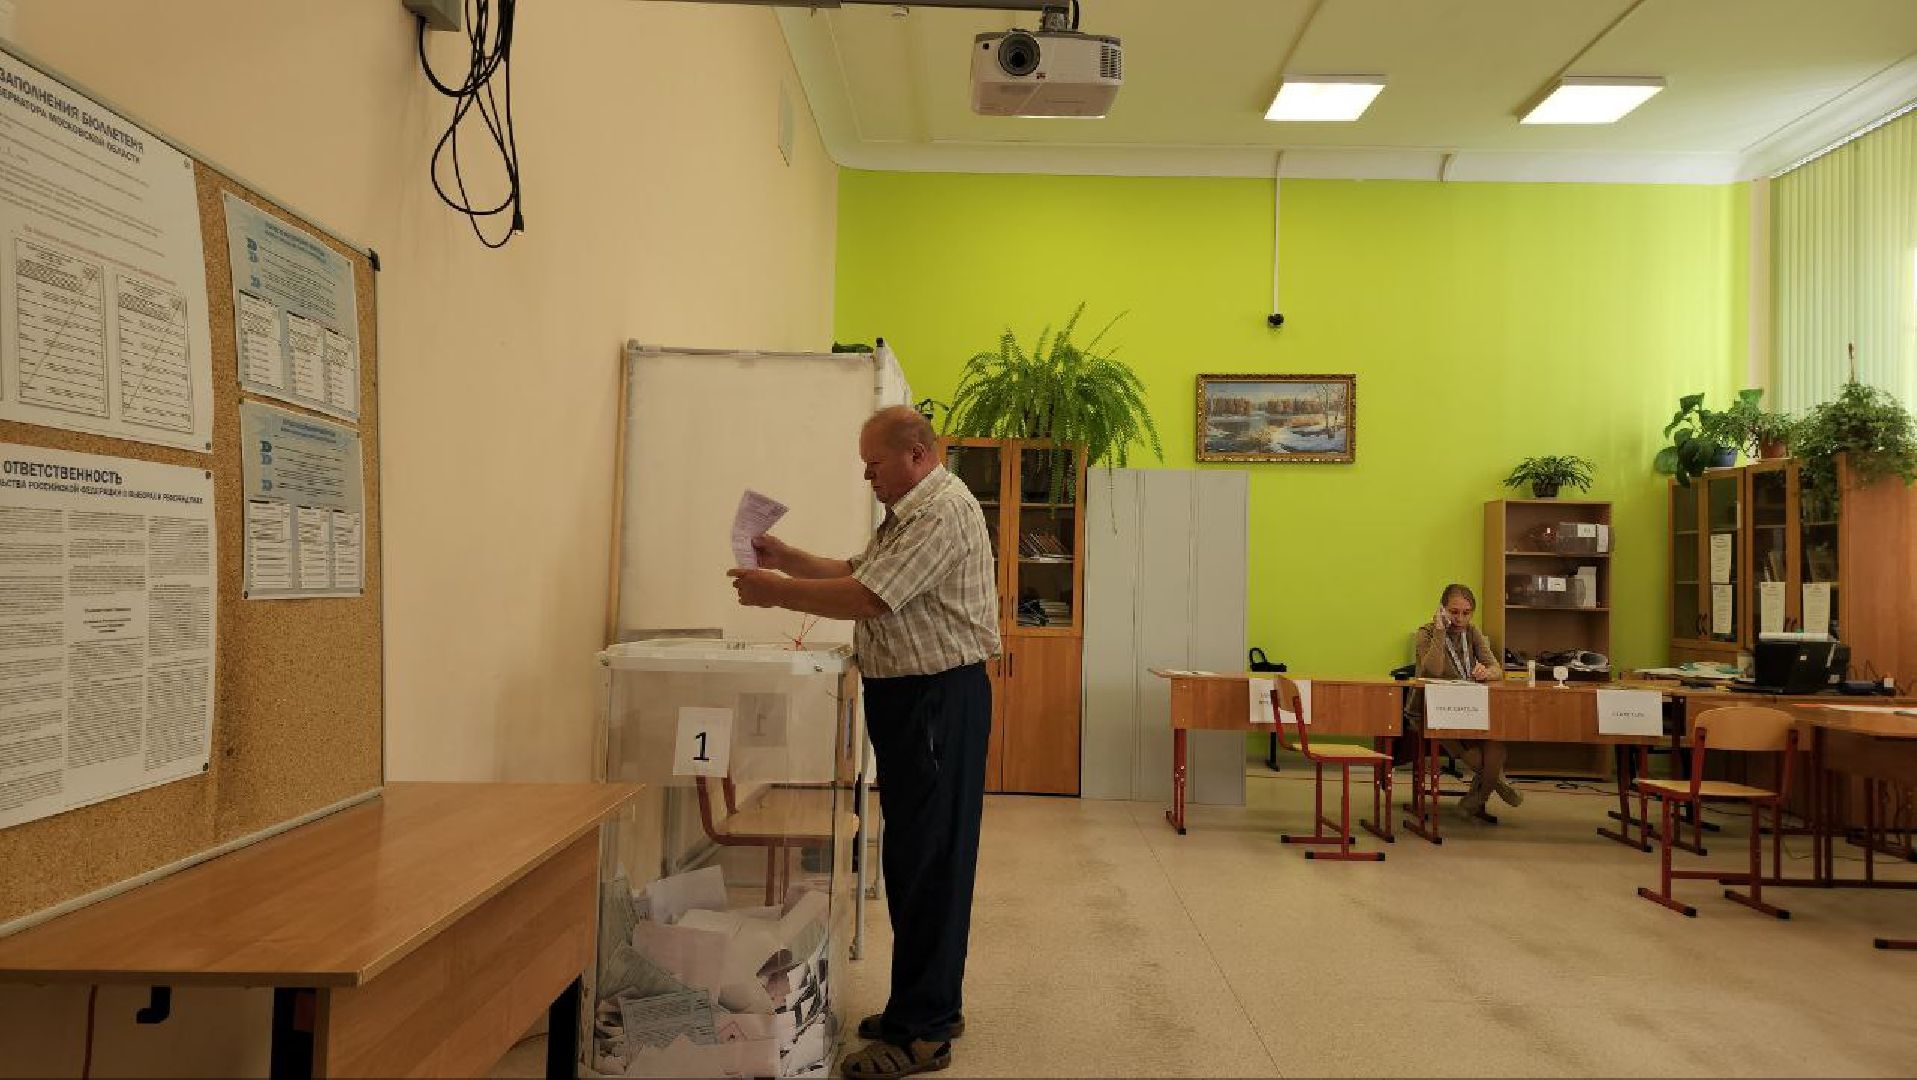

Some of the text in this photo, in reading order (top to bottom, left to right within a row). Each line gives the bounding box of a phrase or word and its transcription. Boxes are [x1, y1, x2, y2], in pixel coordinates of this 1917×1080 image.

[0, 67, 79, 120] ЗАПОЛНЕНИЯ
[82, 112, 144, 154] БЮЛЛЕТЕНЯ
[48, 112, 104, 147] МОСКОВСКОЙ
[106, 142, 140, 164] ОБЛАСТИ
[4, 460, 122, 485] ОТВЕТСТВЕННОСТЬ
[28, 481, 79, 493] РОССИЙСКОЙ
[80, 485, 121, 498] ФЕДЕРАЦИИ
[693, 731, 710, 762] 1
